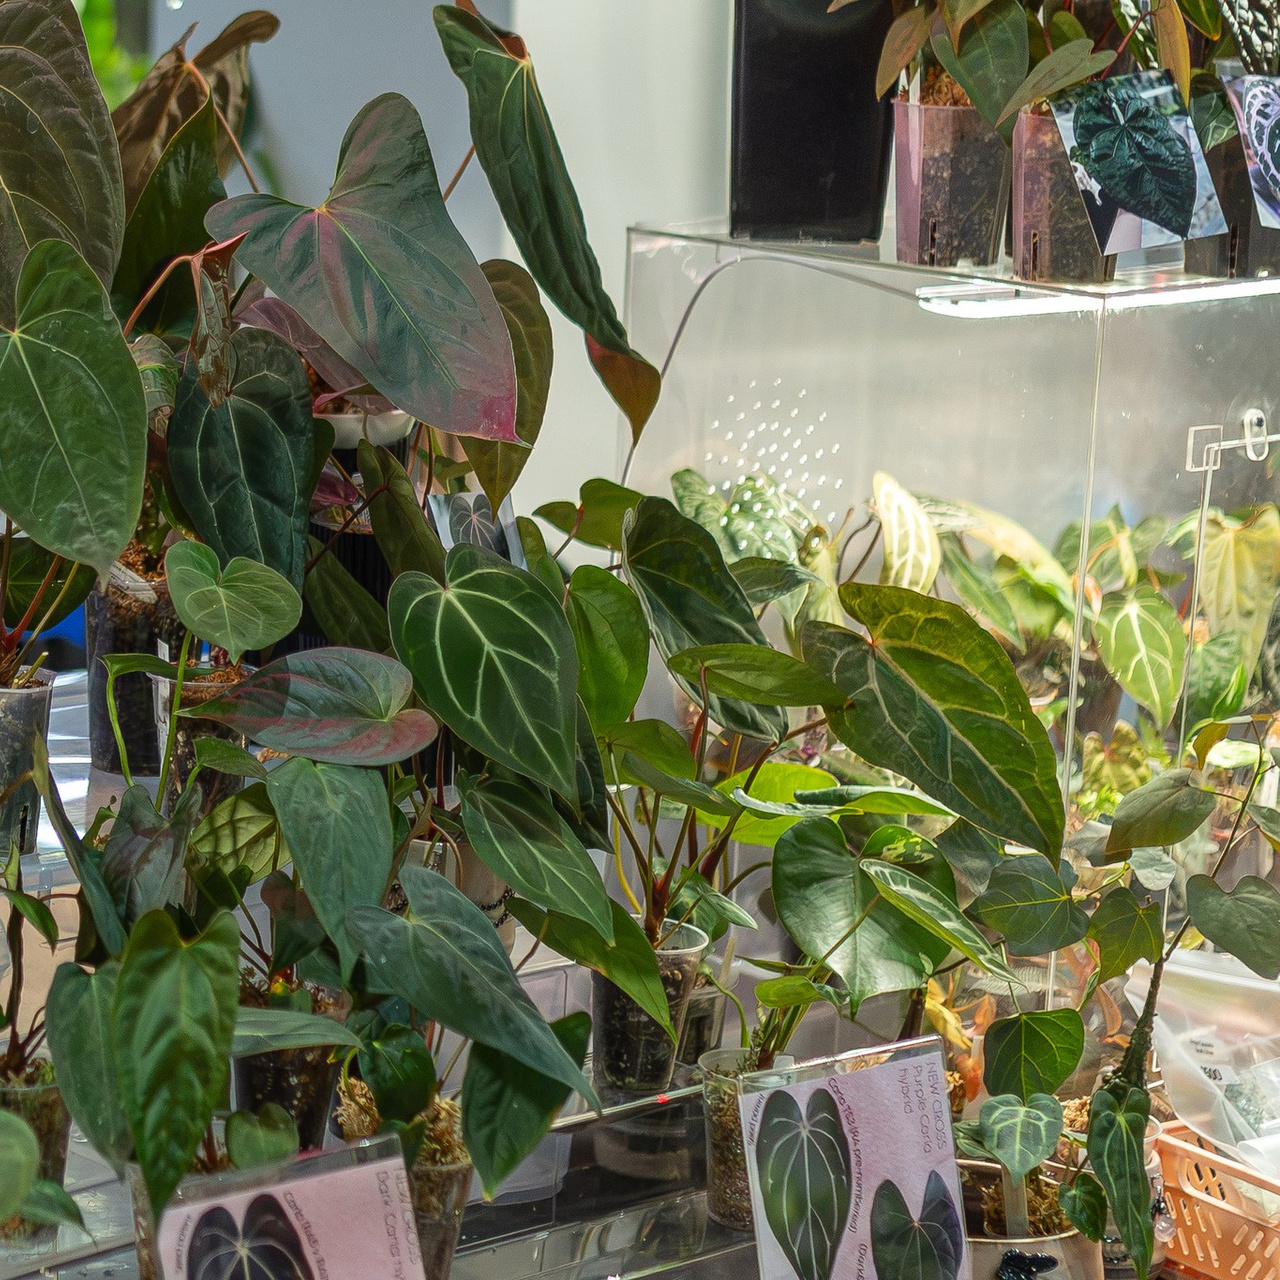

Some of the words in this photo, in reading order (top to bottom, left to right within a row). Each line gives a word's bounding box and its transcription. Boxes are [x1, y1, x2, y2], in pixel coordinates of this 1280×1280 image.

[898, 1067, 915, 1115] hybrid
[912, 1064, 927, 1112] Purple
[925, 1061, 941, 1096] NEW
[932, 1099, 948, 1150] CROSS
